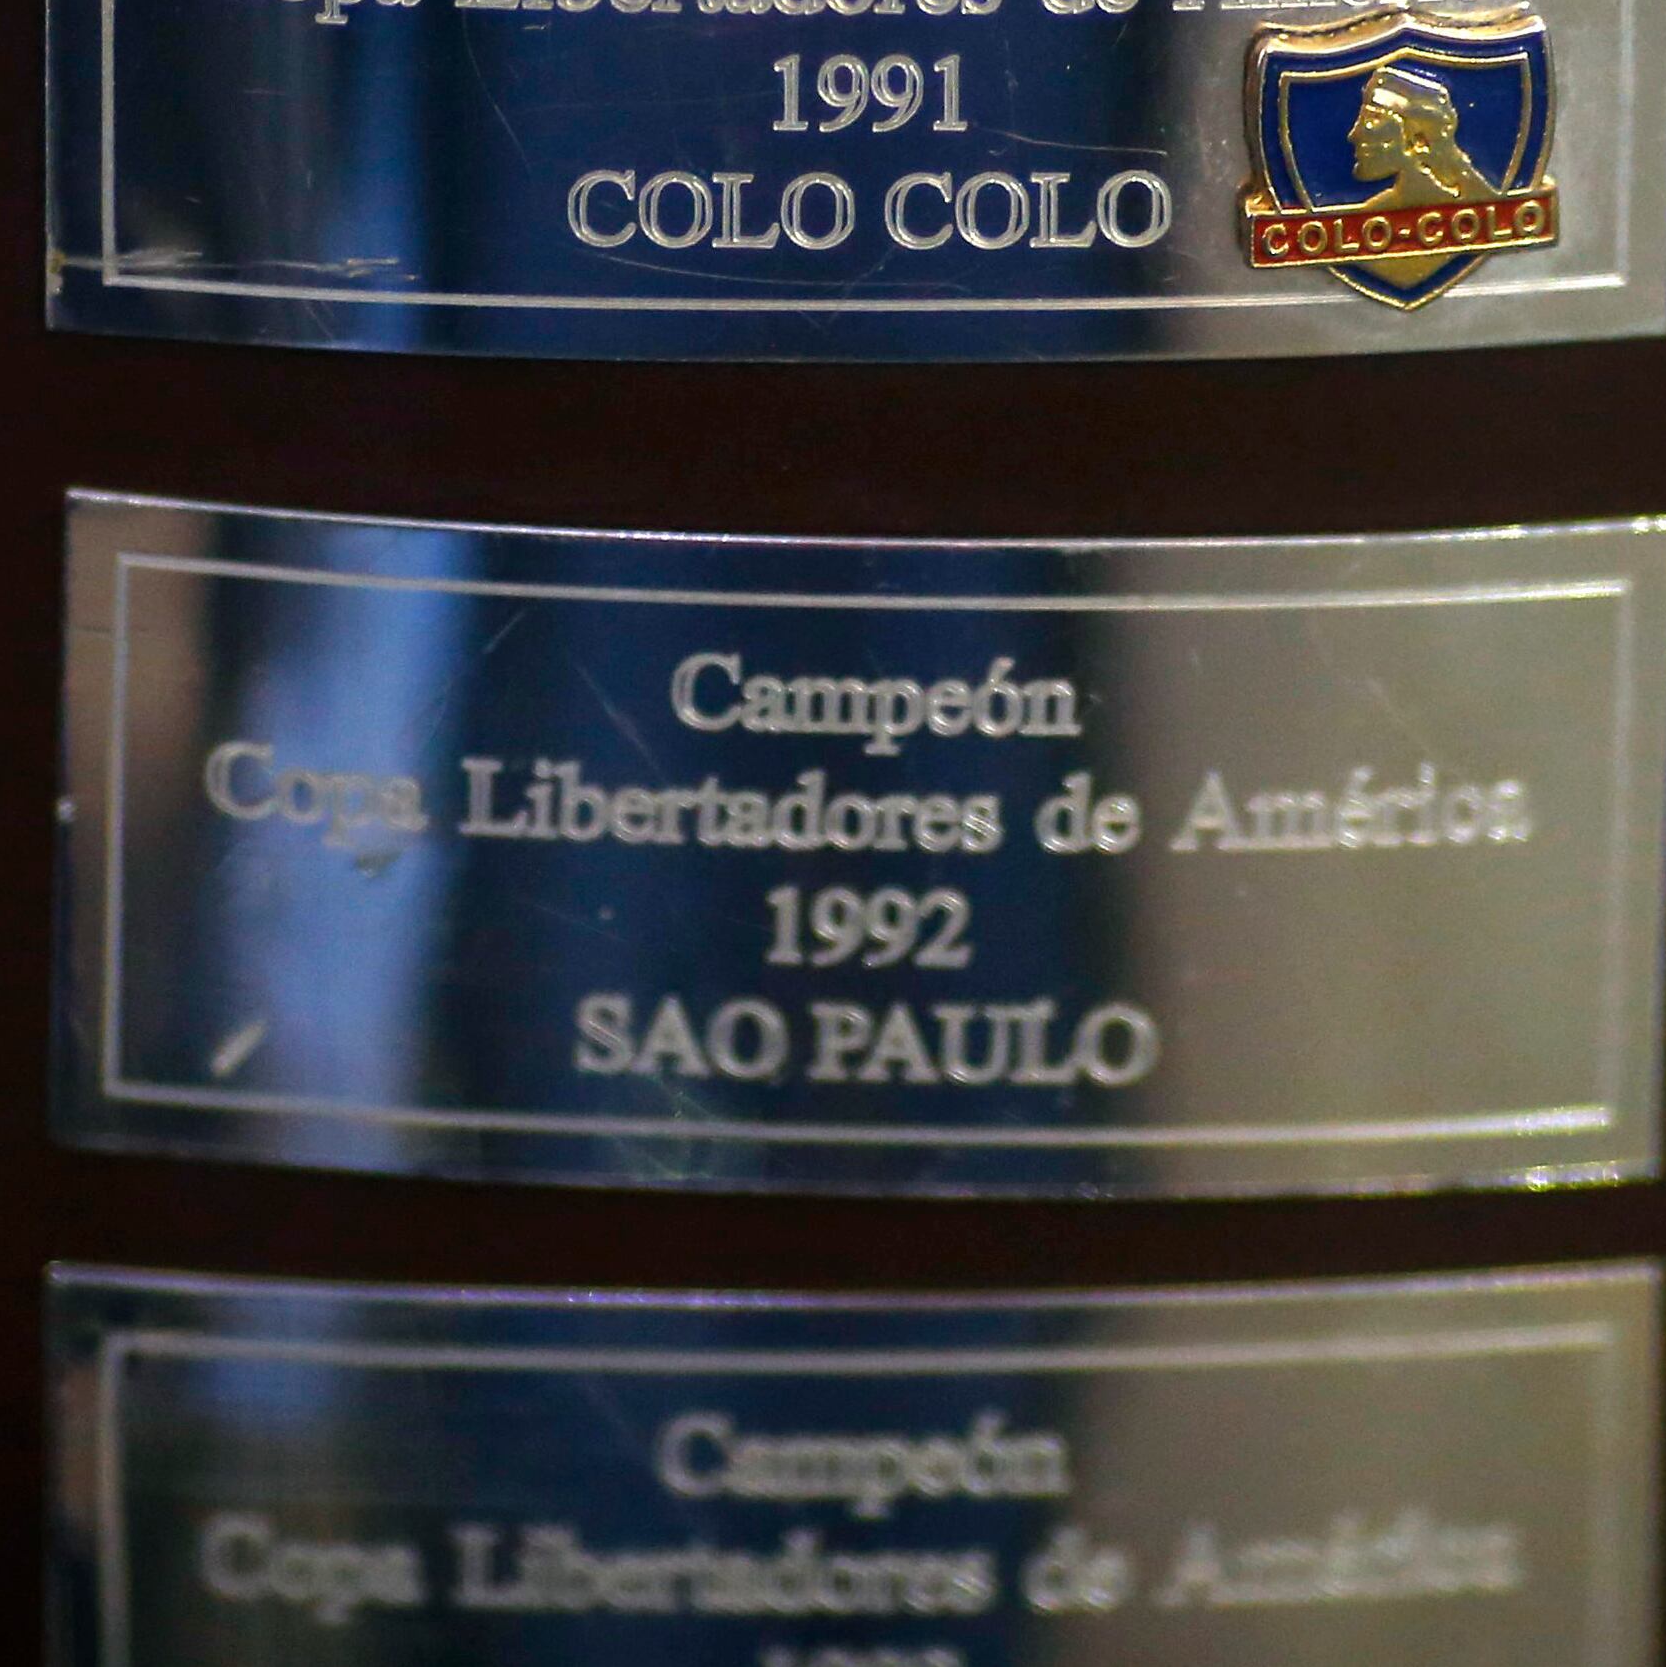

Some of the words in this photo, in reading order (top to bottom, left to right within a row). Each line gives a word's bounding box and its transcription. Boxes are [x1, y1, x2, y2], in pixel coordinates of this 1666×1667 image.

[773, 54, 967, 133] 1991
[569, 170, 854, 251] COLO
[885, 170, 1171, 251] COLO
[1262, 200, 1545, 256] COLO-COLO
[672, 653, 1080, 756] Campeón
[207, 742, 427, 849] Copa
[462, 758, 1001, 853] Libertadores
[1036, 768, 1139, 854] de
[1171, 759, 1531, 851] América
[765, 886, 971, 969] 1992
[575, 996, 783, 1082] SAO
[809, 999, 1158, 1083] PAULO
[659, 1411, 1070, 1516] Campeón
[199, 1518, 421, 1622] Copa
[455, 1523, 995, 1615] Libertadores
[1025, 1523, 1130, 1611] de
